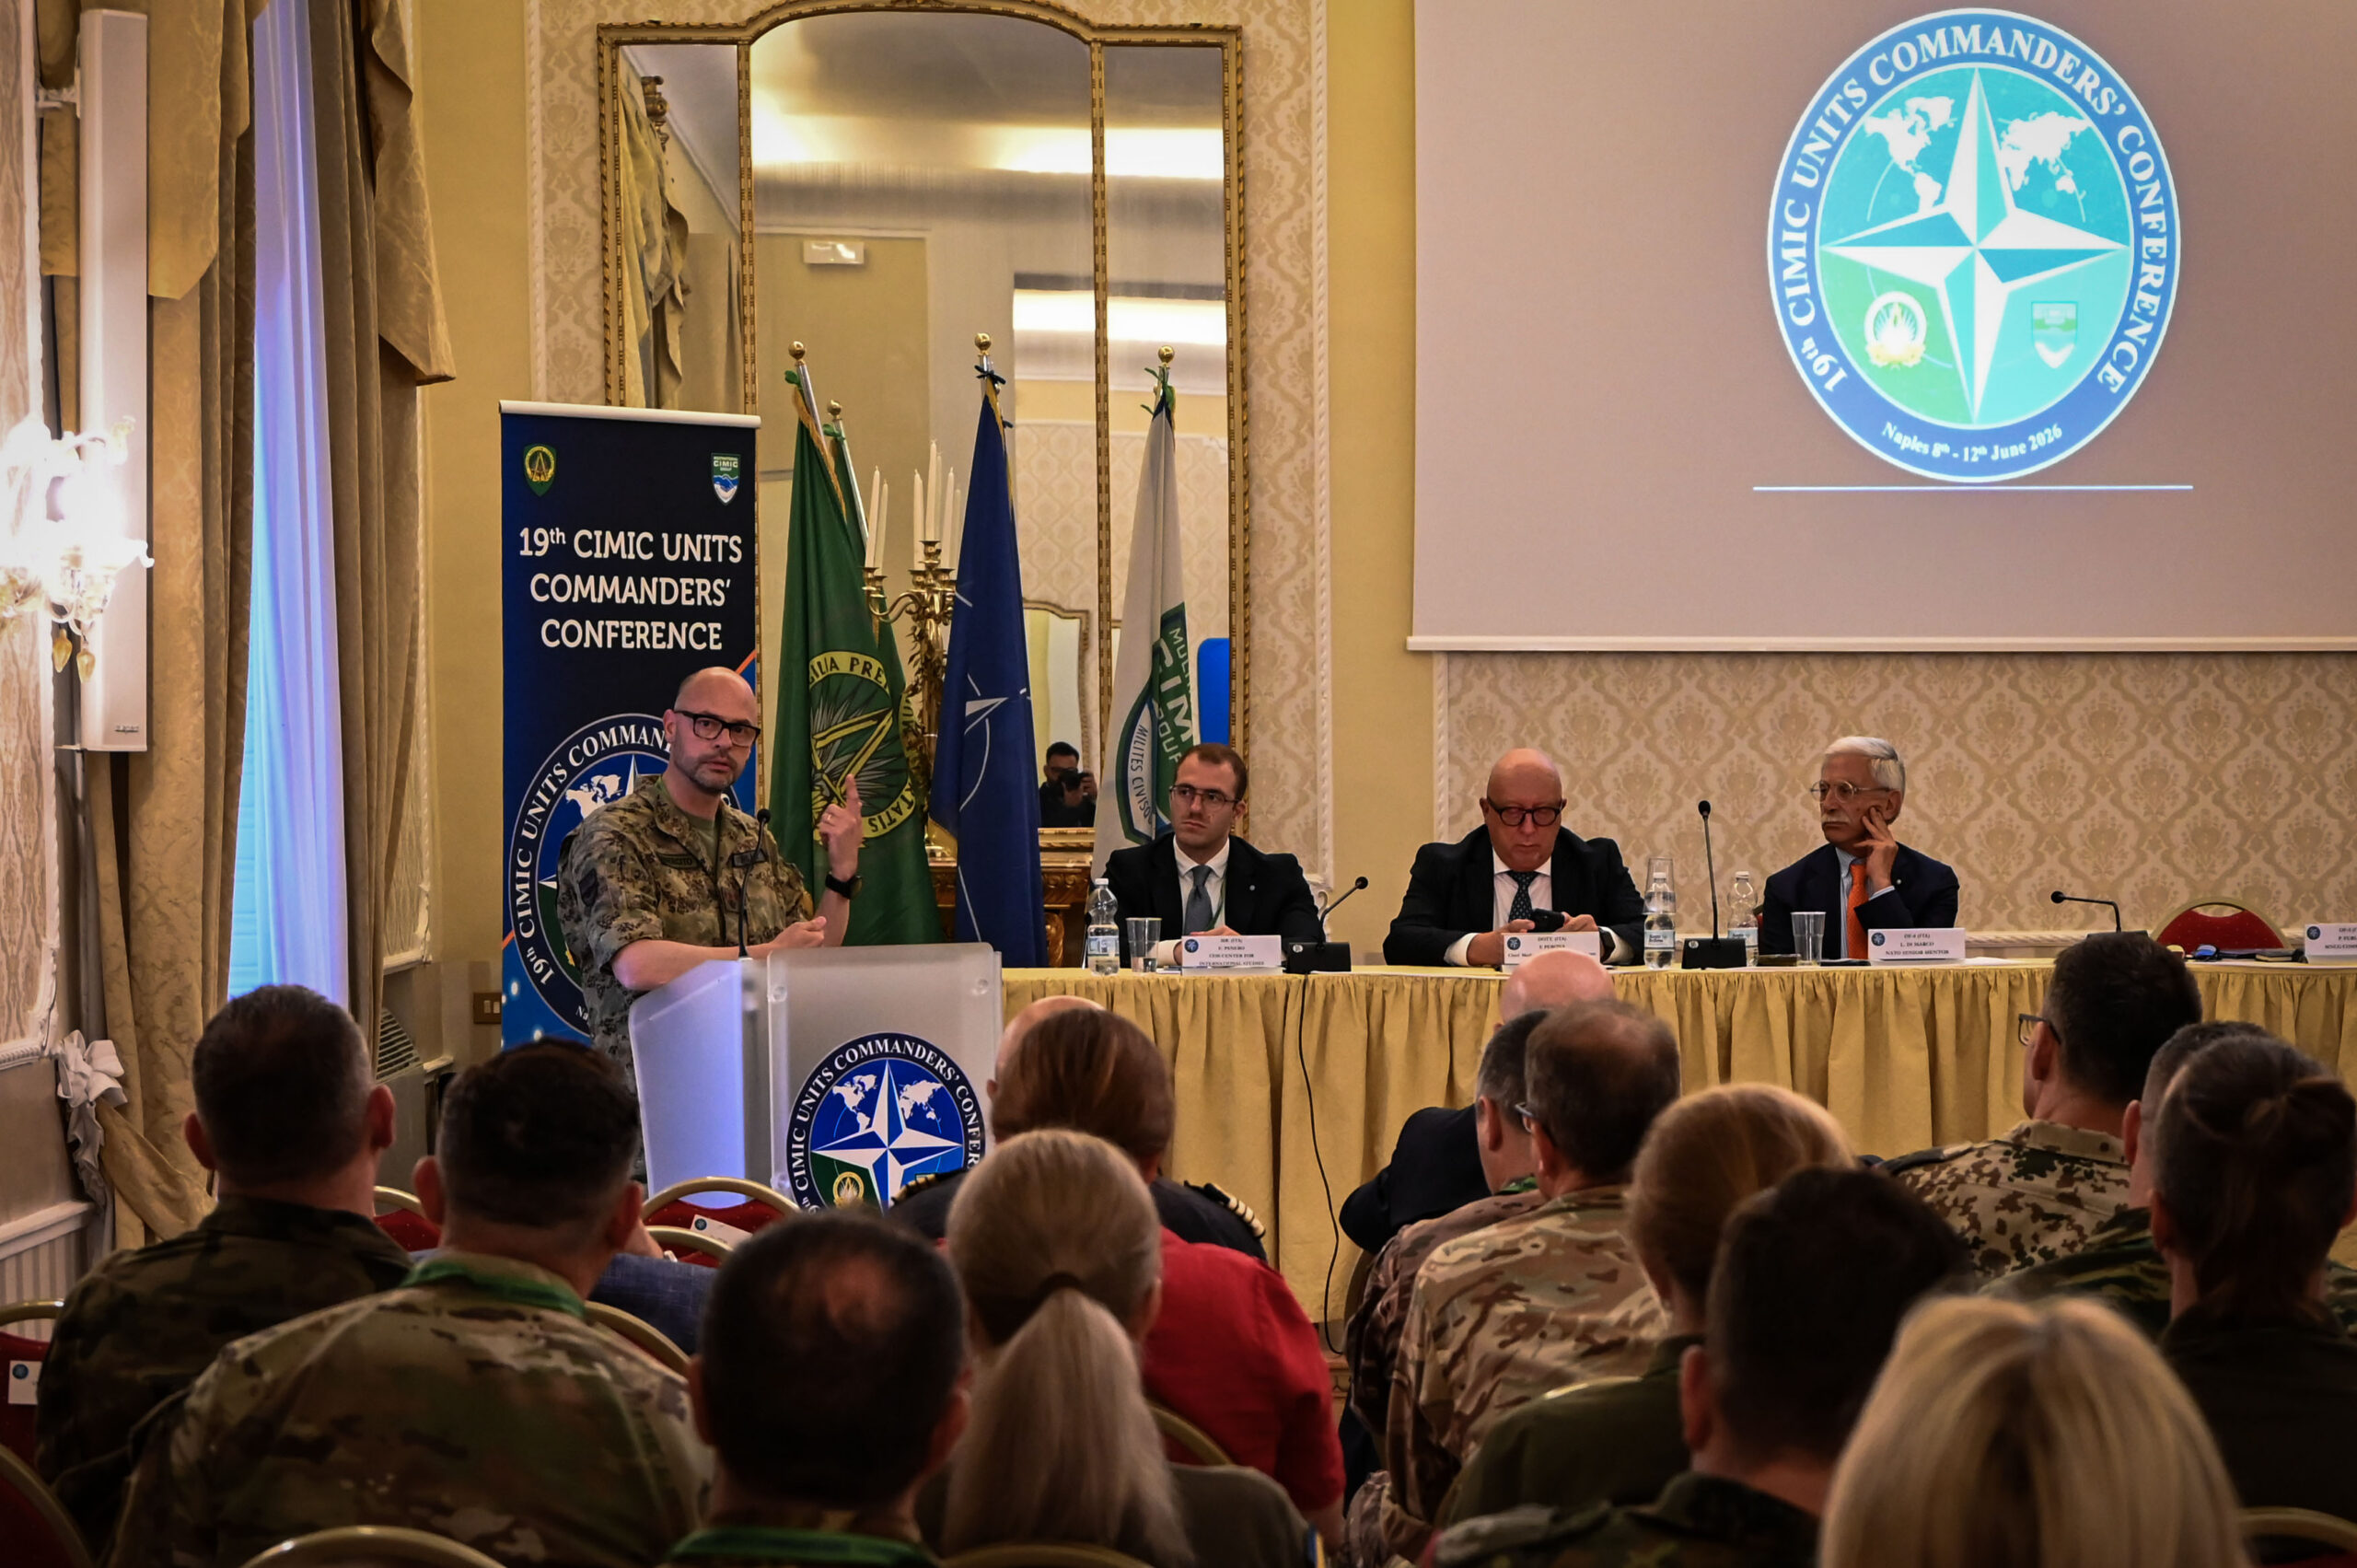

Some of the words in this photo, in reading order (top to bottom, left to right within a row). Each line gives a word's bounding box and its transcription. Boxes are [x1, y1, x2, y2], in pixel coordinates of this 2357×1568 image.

[1794, 78, 1868, 190] UNITS
[1783, 199, 1817, 328] CIMIC
[2096, 124, 2167, 394] CONFERENCE
[1800, 336, 1849, 393] 19th
[1881, 421, 1930, 455] Naples
[1932, 442, 1950, 458] 8th
[1963, 446, 1988, 462] 12th
[1991, 442, 2026, 460] June
[2028, 423, 2063, 451] 2026
[519, 528, 566, 557] 19th
[574, 529, 654, 561] CIMIC
[662, 533, 742, 563] UNITS
[541, 619, 723, 650] CONFERENCE
[568, 725, 671, 768] COMMAN
[522, 762, 568, 839] UNITS
[516, 849, 535, 937] CIMIC
[526, 947, 554, 986] 19th
[796, 1067, 833, 1122] UNITS
[956, 1085, 981, 1169] CONFER
[792, 1128, 808, 1191] CIMIC
